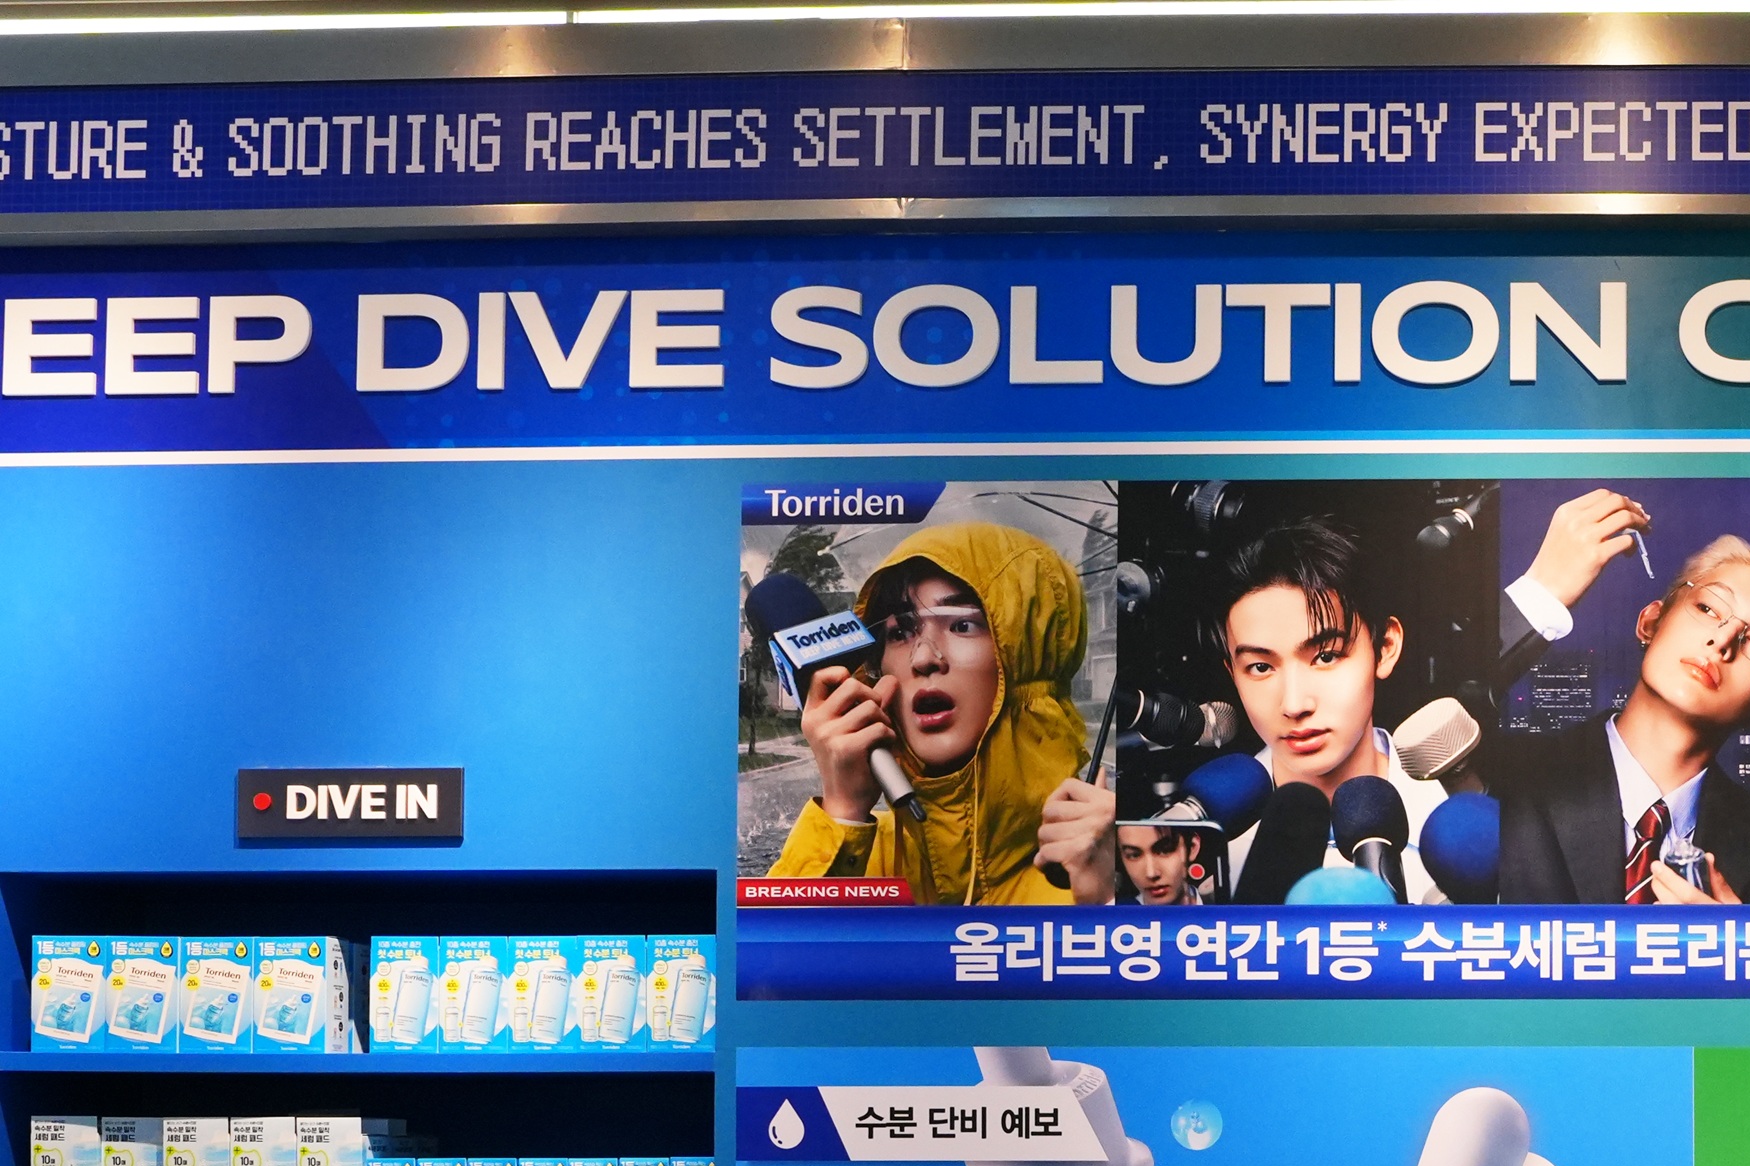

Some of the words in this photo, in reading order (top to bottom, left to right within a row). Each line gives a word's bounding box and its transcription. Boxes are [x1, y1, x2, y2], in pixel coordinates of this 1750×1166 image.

[172, 117, 203, 177] &
[227, 110, 501, 176] SOOTHING
[525, 106, 767, 171] REACHES
[1198, 99, 1448, 163] SYNERGY
[2, 293, 313, 396] EEP
[355, 287, 725, 392] DIVE
[769, 278, 1628, 387] SOLUTION
[764, 486, 905, 516] Torriden
[786, 618, 860, 648] Torriden
[285, 782, 387, 819] DIVE
[395, 782, 438, 818] IN
[743, 884, 840, 898] BREAKING
[844, 884, 900, 898] NEWS
[948, 918, 1161, 981] 올리브영
[1175, 918, 1285, 980] 연간
[1400, 918, 1616, 980] 수분세럼
[56, 965, 94, 980] Torriden
[853, 1104, 917, 1139] 수분
[927, 1104, 988, 1139] 단비
[1000, 1104, 1063, 1138] 예보
